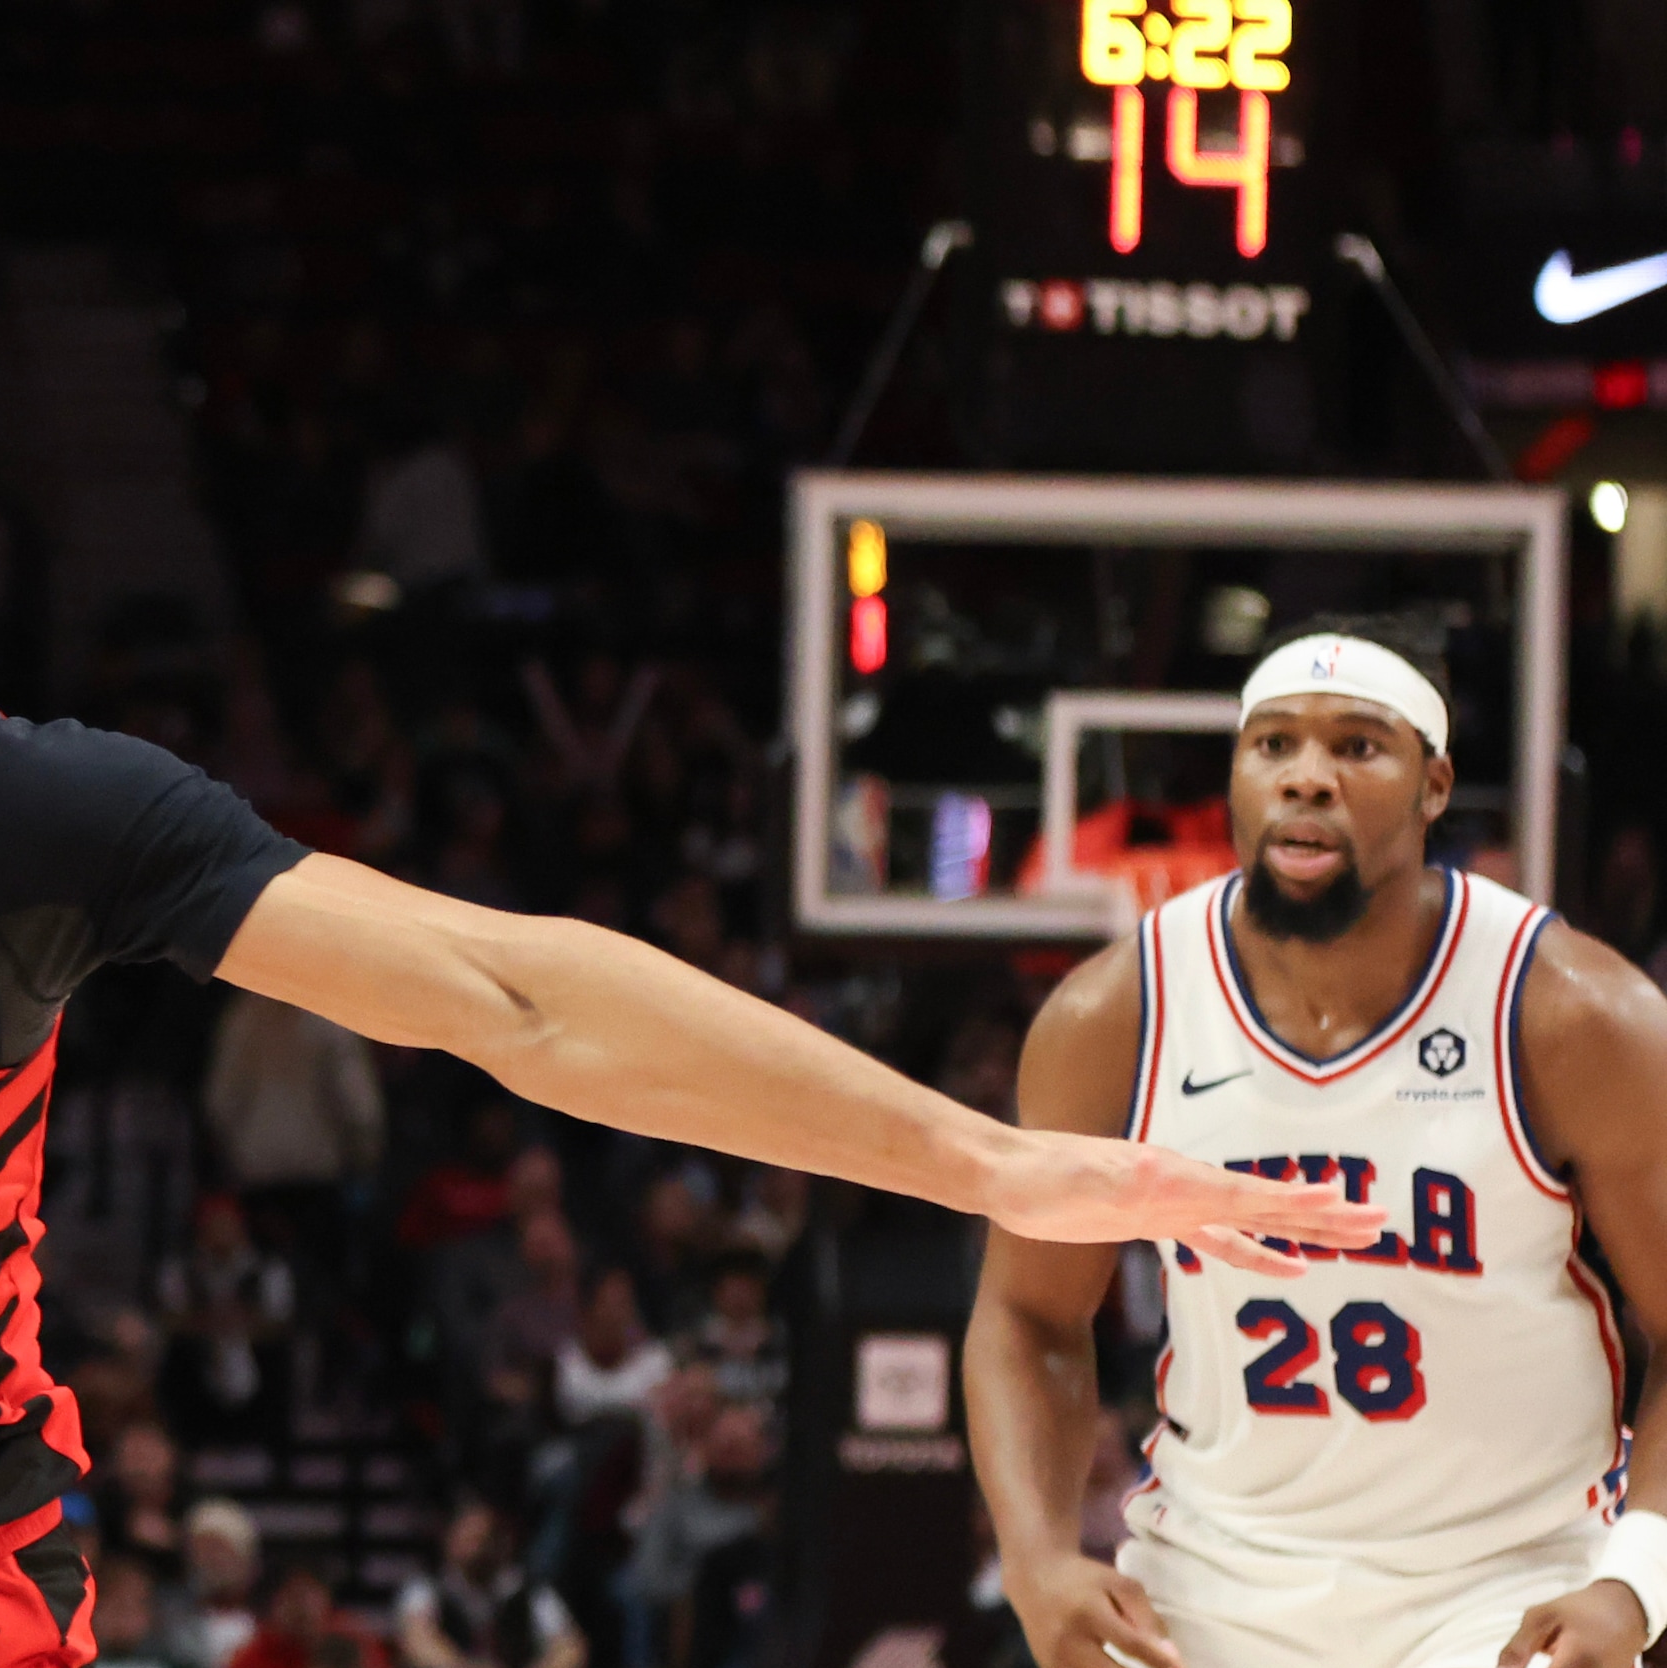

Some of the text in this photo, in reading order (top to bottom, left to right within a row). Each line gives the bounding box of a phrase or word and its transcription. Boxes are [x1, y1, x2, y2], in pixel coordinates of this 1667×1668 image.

[1081, 0, 1294, 91] 6:22
[1110, 85, 1271, 258] 14
[1085, 278, 1312, 342] TISSOT
[1234, 1298, 1427, 1423] 28
